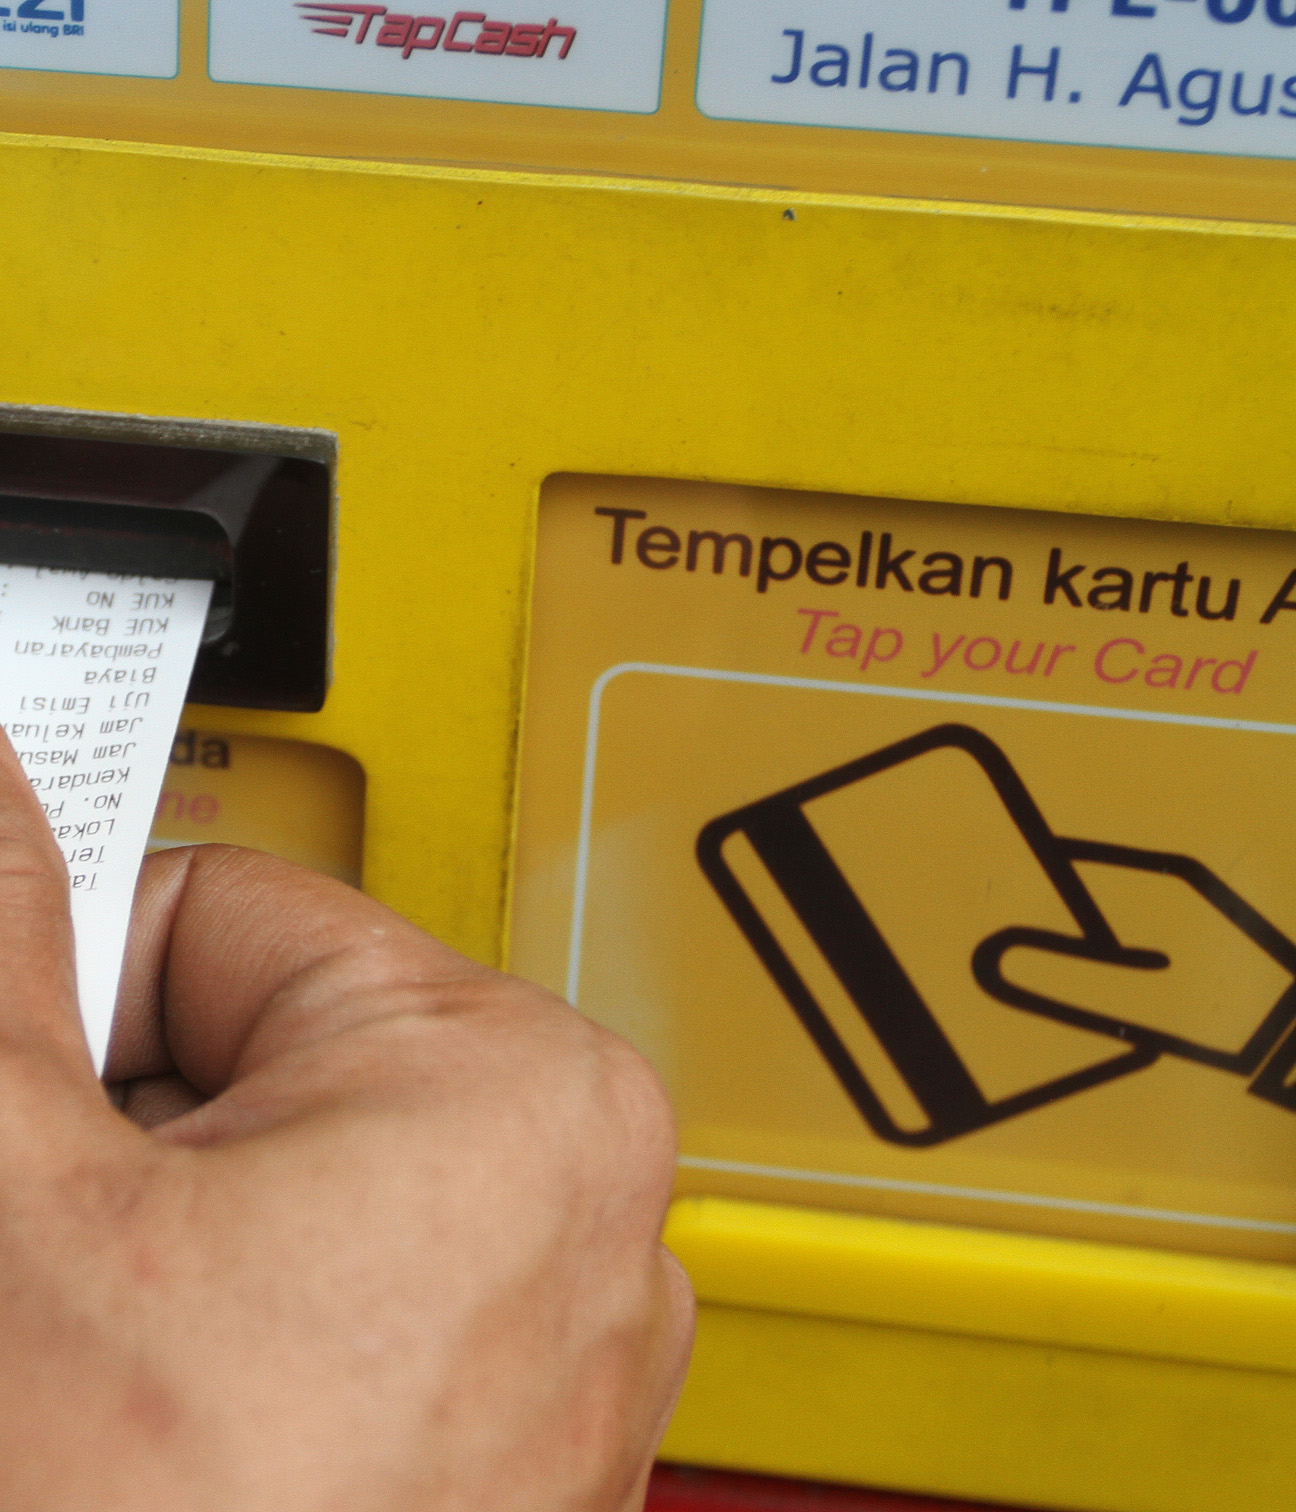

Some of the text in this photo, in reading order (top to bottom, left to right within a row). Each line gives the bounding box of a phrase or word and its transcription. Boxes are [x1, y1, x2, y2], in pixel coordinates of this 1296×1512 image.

[3, 19, 17, 32] isi
[20, 22, 59, 37] ulang
[63, 24, 84, 36] BRI
[294, 2, 577, 60] TapCash
[771, 28, 970, 96] Jalan
[1006, 44, 1082, 104] H.
[594, 506, 1013, 601] Tempelkan
[1043, 547, 1242, 621] kartu
[86, 591, 115, 608] No
[130, 592, 176, 610] KUE
[51, 616, 110, 636] Bank
[124, 617, 170, 636] KUE
[14, 640, 163, 662] Pembayaran
[797, 608, 1259, 695] Tap your Card
[83, 666, 157, 685] Biaya
[18, 691, 150, 715] Uji Emisi
[100, 717, 143, 734] Jam
[14, 749, 79, 766] Masu
[92, 742, 136, 760] Jam
[84, 792, 122, 810] No.
[50, 818, 116, 841] Loka
[69, 872, 97, 891] Ta
